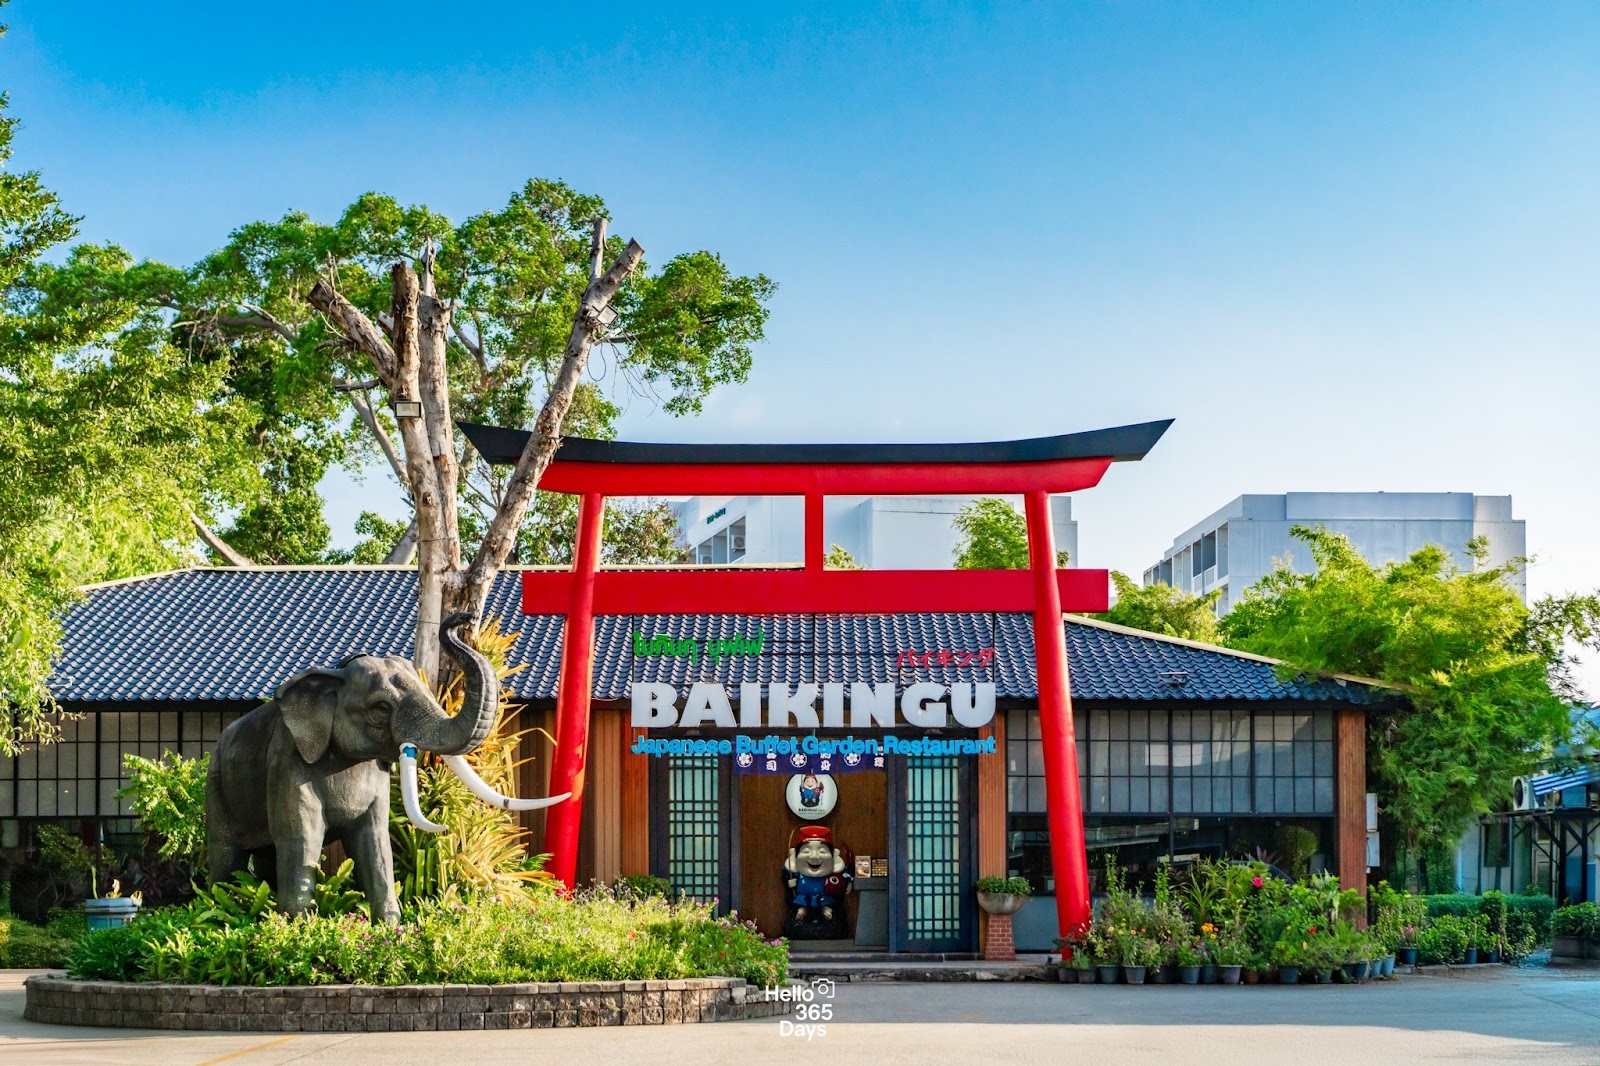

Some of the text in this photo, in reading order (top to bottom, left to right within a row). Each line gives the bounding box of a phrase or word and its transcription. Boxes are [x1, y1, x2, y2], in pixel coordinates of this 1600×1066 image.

[630, 682, 997, 728] BAIKINGU
[631, 735, 996, 757] Japanese Buffet Garden Restaurant
